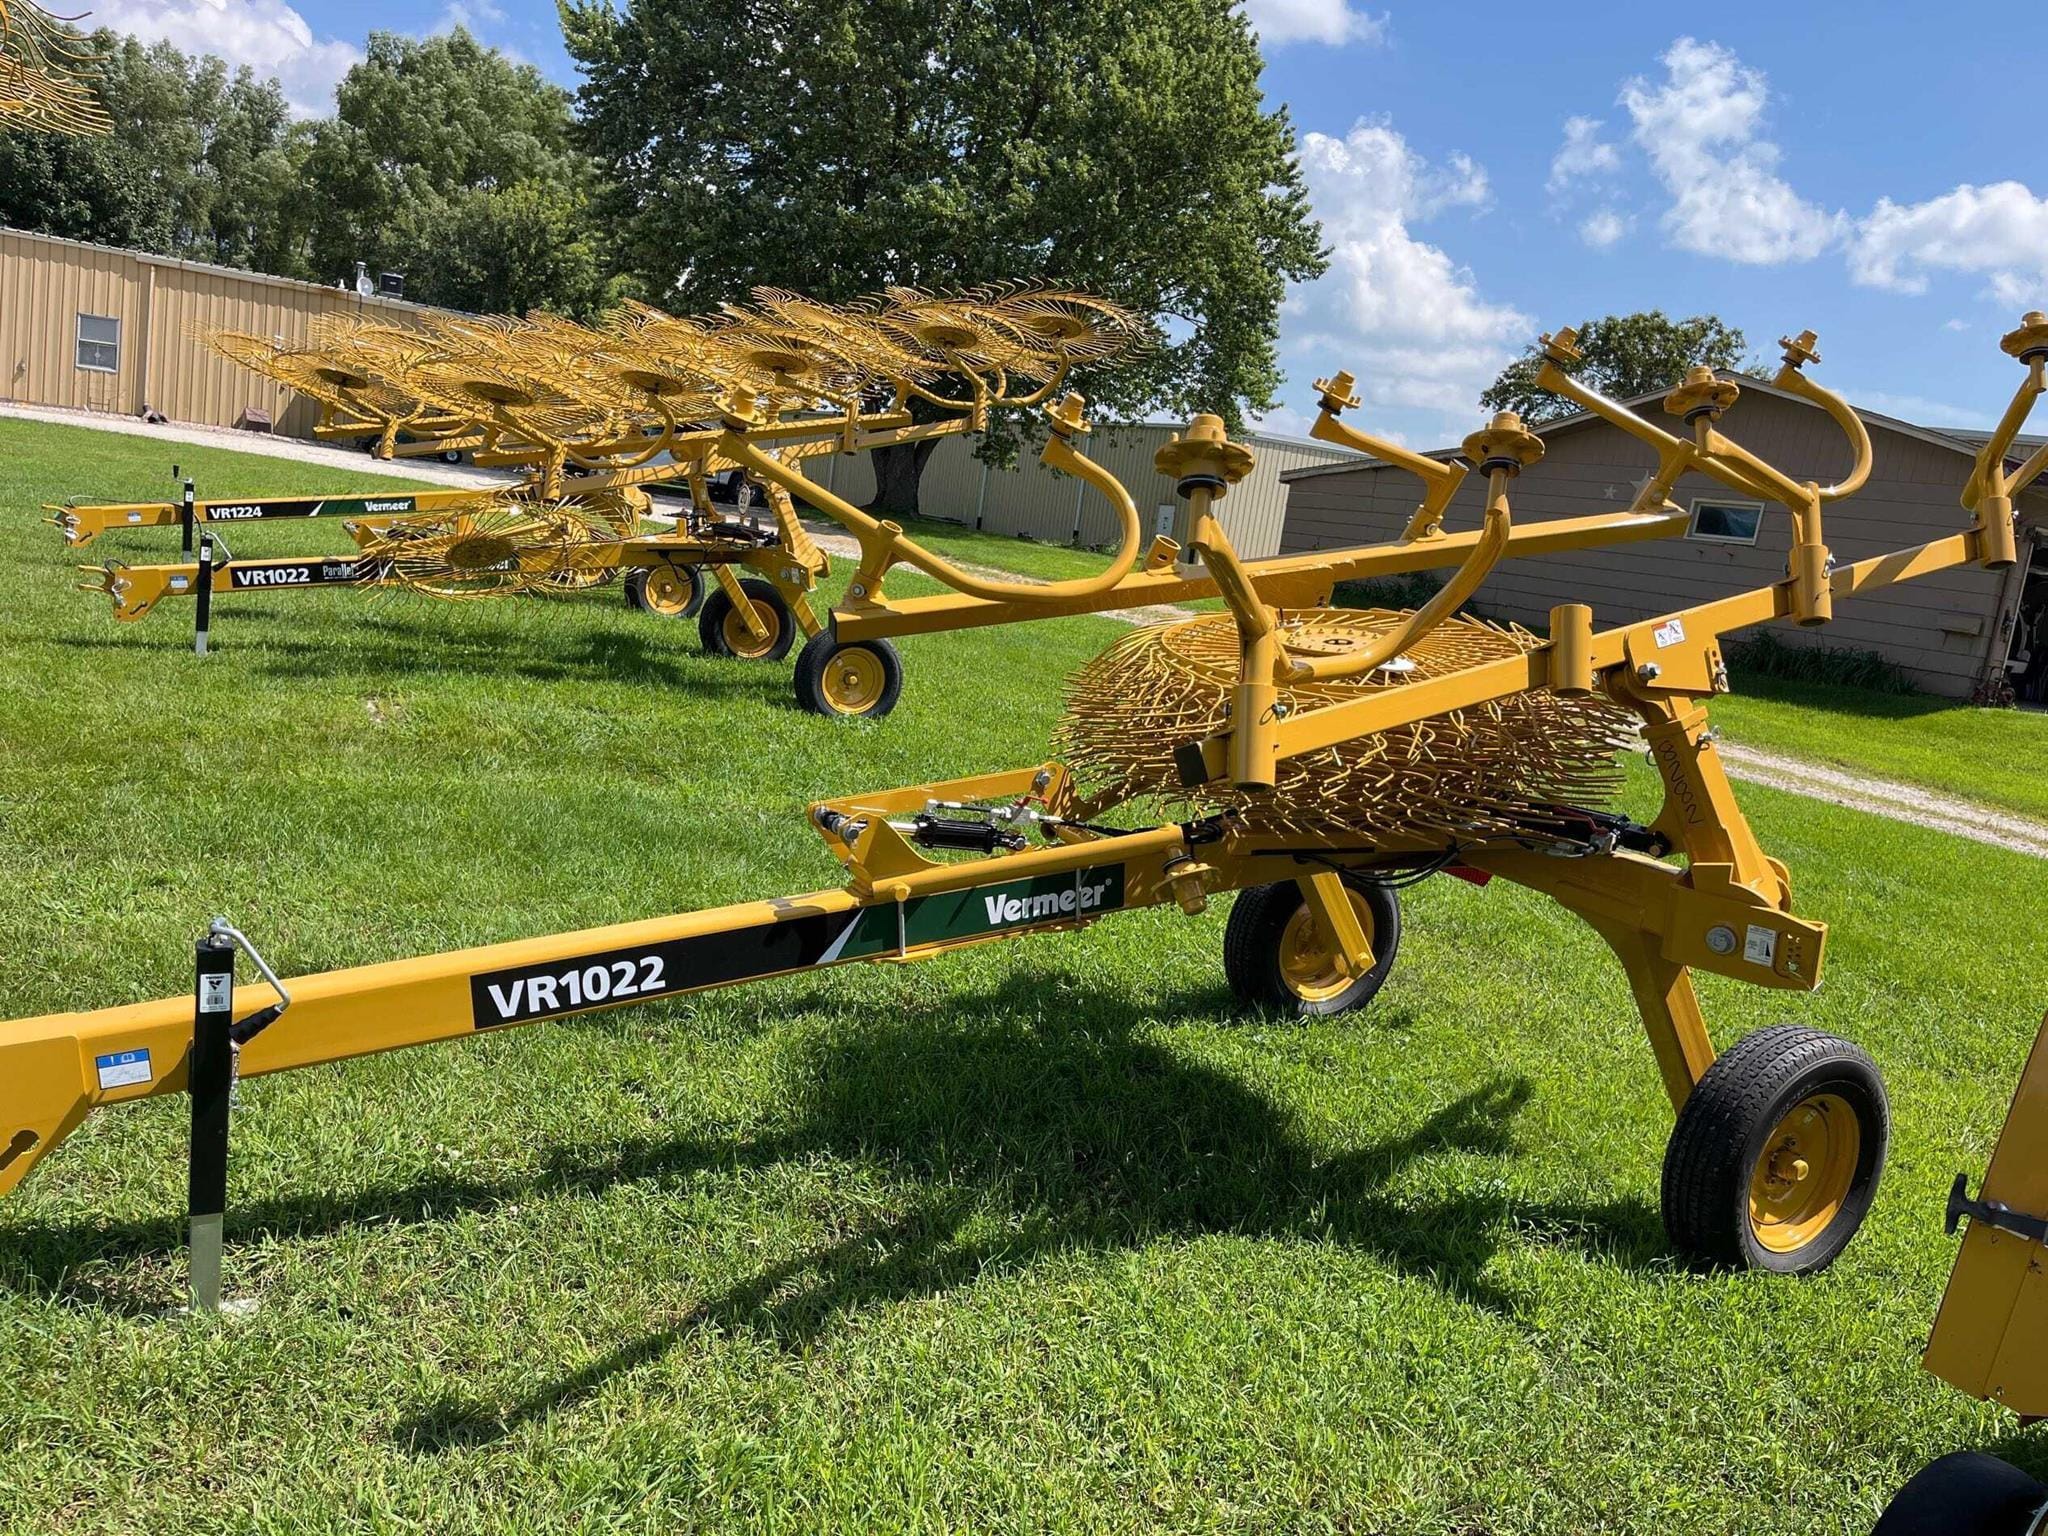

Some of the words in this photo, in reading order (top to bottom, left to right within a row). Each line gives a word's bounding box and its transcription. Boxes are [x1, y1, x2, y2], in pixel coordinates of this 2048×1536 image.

[210, 506, 262, 519] VR1224
[365, 500, 409, 511] Vermeer
[237, 568, 310, 586] VR1022
[985, 884, 1105, 925] Vermeer
[487, 955, 666, 1018] VR1022
